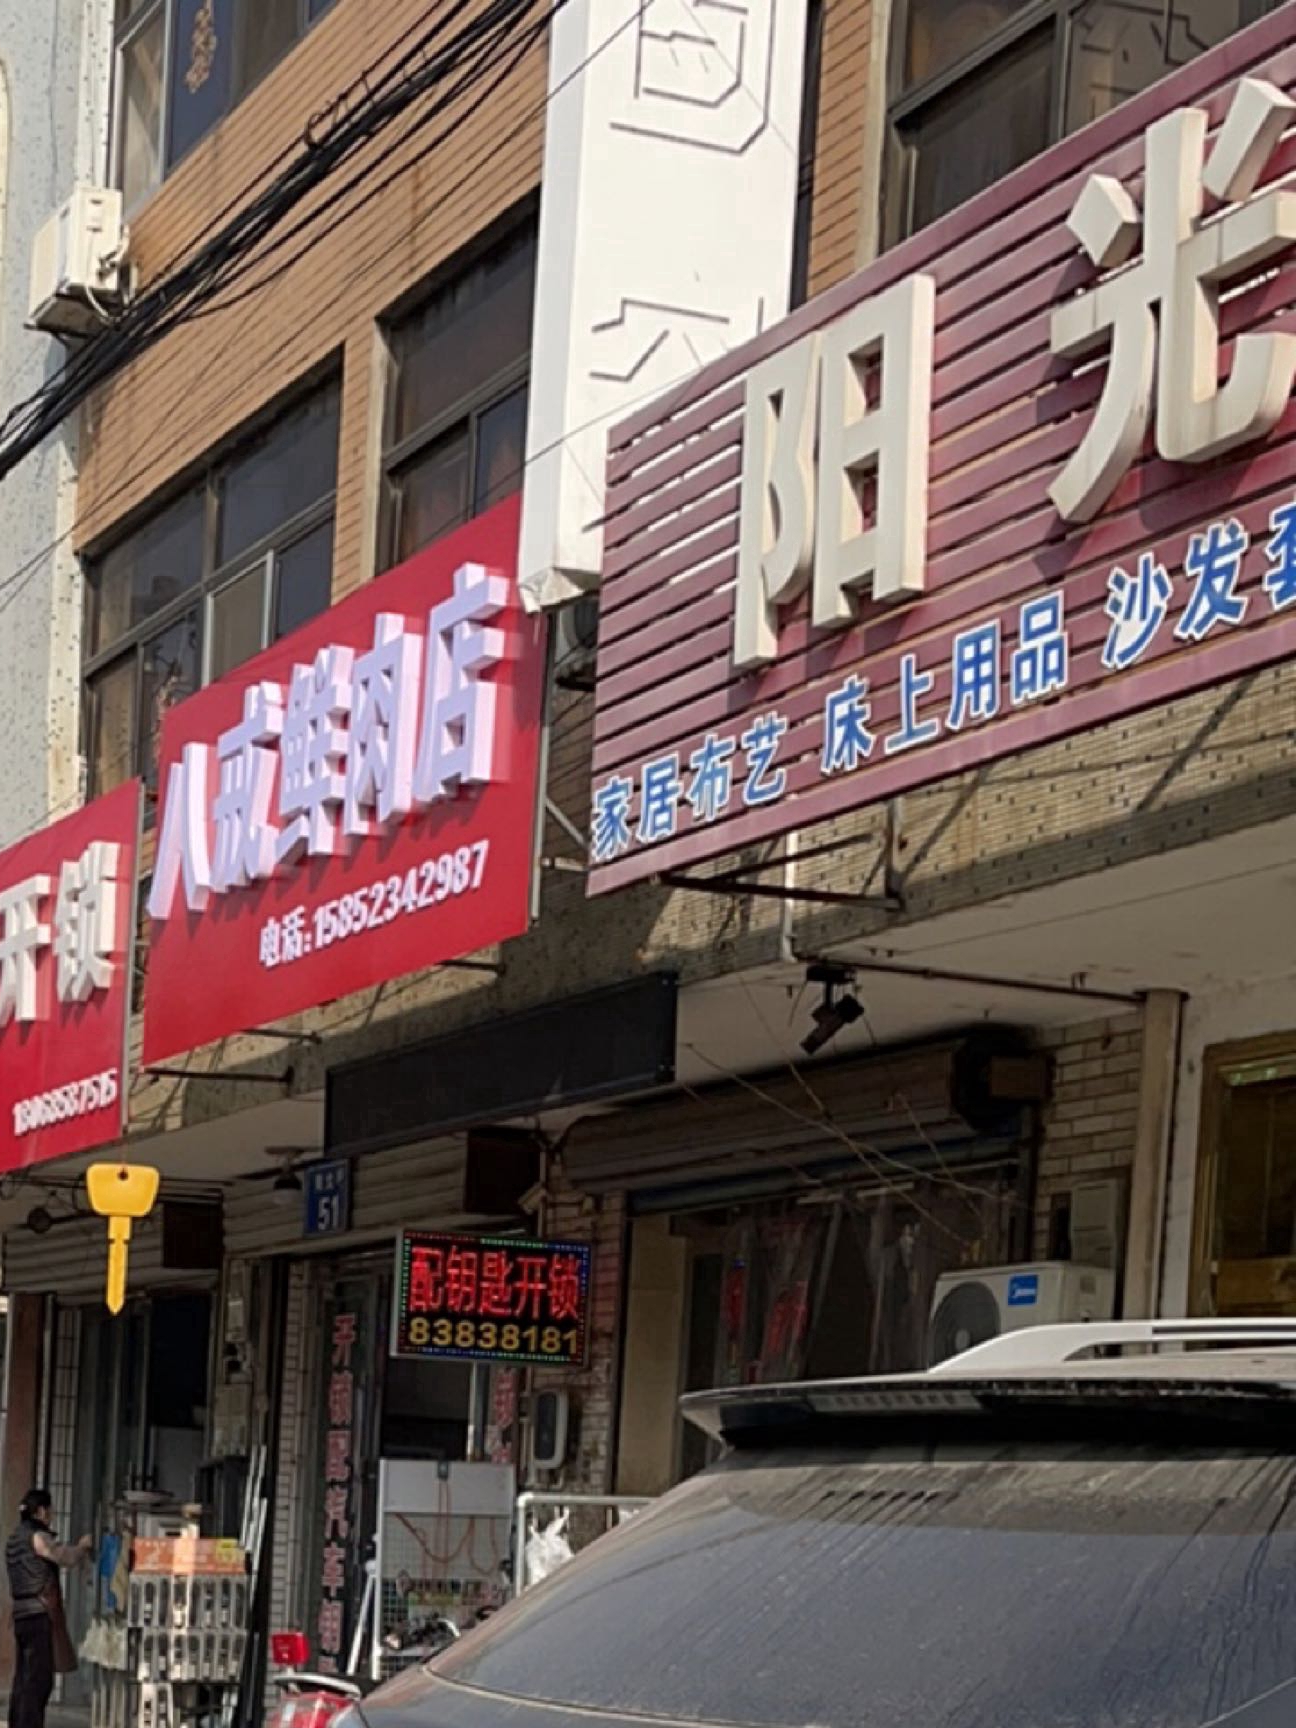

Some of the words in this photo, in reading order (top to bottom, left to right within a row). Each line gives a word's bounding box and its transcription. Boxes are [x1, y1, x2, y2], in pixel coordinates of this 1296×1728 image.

[733, 79, 1296, 668] 阳光
[146, 562, 512, 920] 八戒鲜肉店
[590, 711, 787, 861] 家居布艺
[820, 589, 1067, 773] 床上用品
[317, 1194, 340, 1231] 51
[409, 1245, 580, 1319] 配钥匙开锁
[408, 1317, 578, 1354] 83838181
